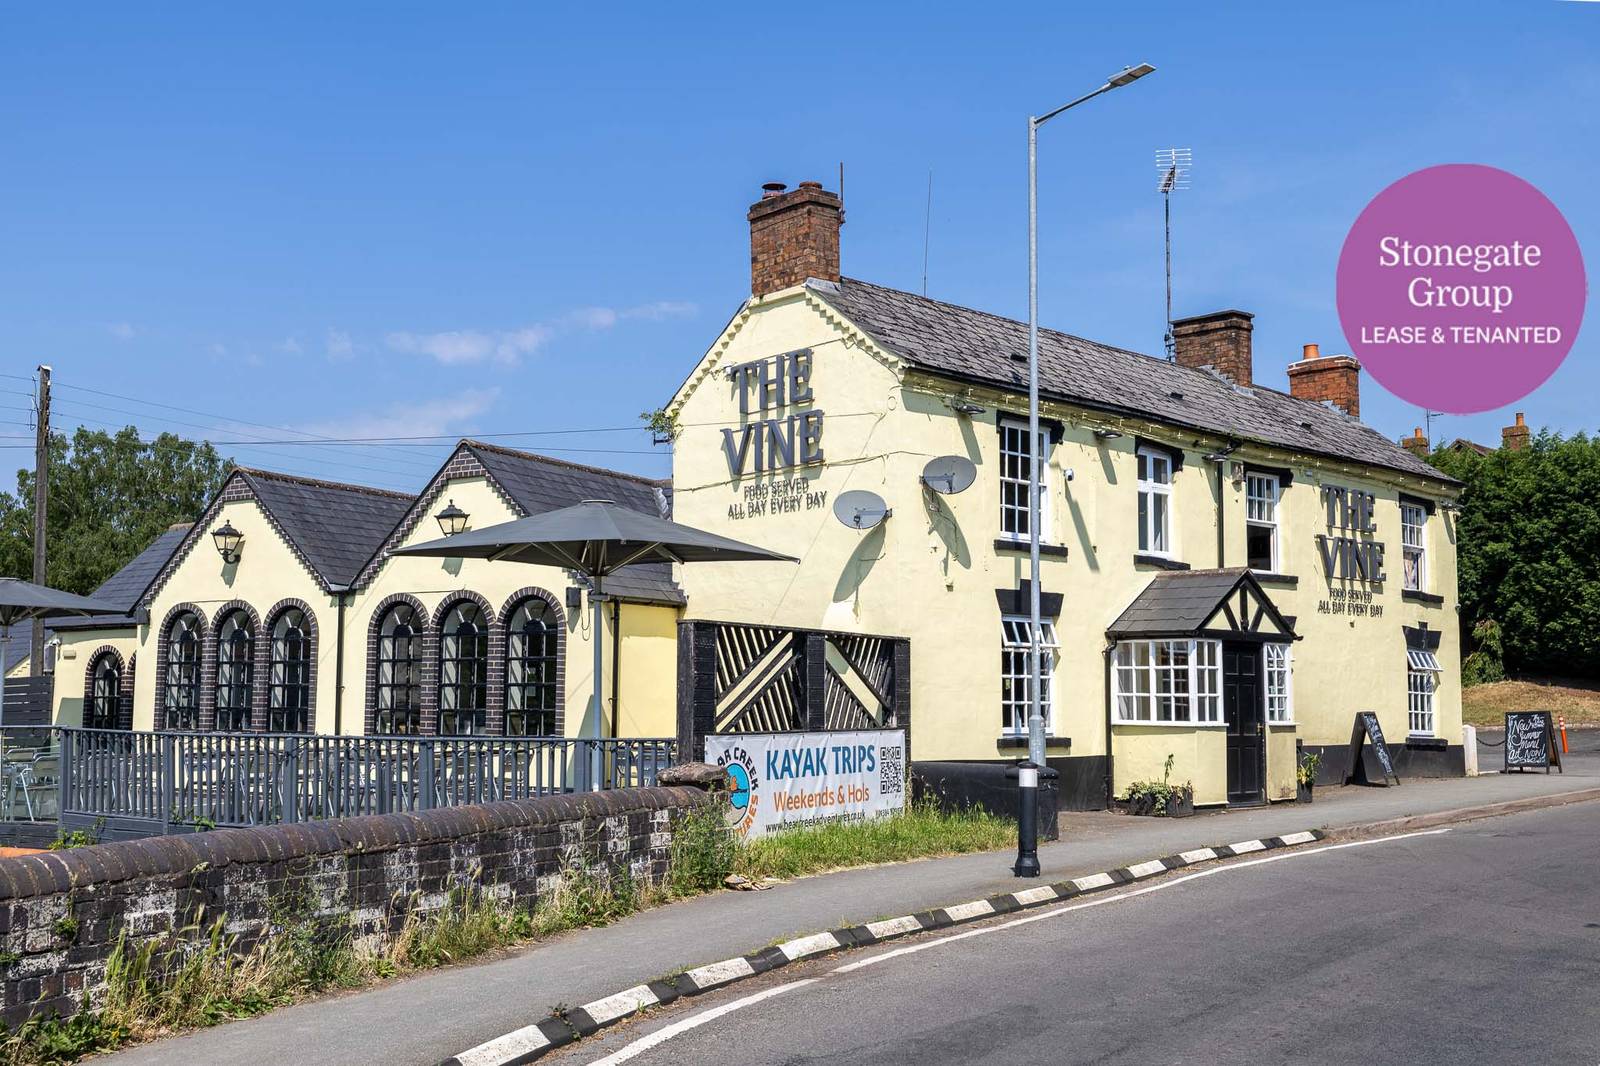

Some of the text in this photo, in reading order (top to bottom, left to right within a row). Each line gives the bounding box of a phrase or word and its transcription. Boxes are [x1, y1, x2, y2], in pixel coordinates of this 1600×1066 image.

[730, 348, 814, 414] THE
[720, 409, 825, 476] VINE
[728, 490, 828, 520] ALL DAY EVERY DAY
[744, 478, 809, 501] FOOD SERVED
[1320, 484, 1377, 533] THE
[1314, 534, 1387, 582] VINE
[1318, 600, 1384, 618] ALL DAY EVERY DAY
[1329, 588, 1373, 604] FOOD SERVED
[733, 746, 759, 791] CREEK
[766, 744, 876, 780] KAYAK TRIPS
[773, 783, 870, 812] Weekends & Hols
